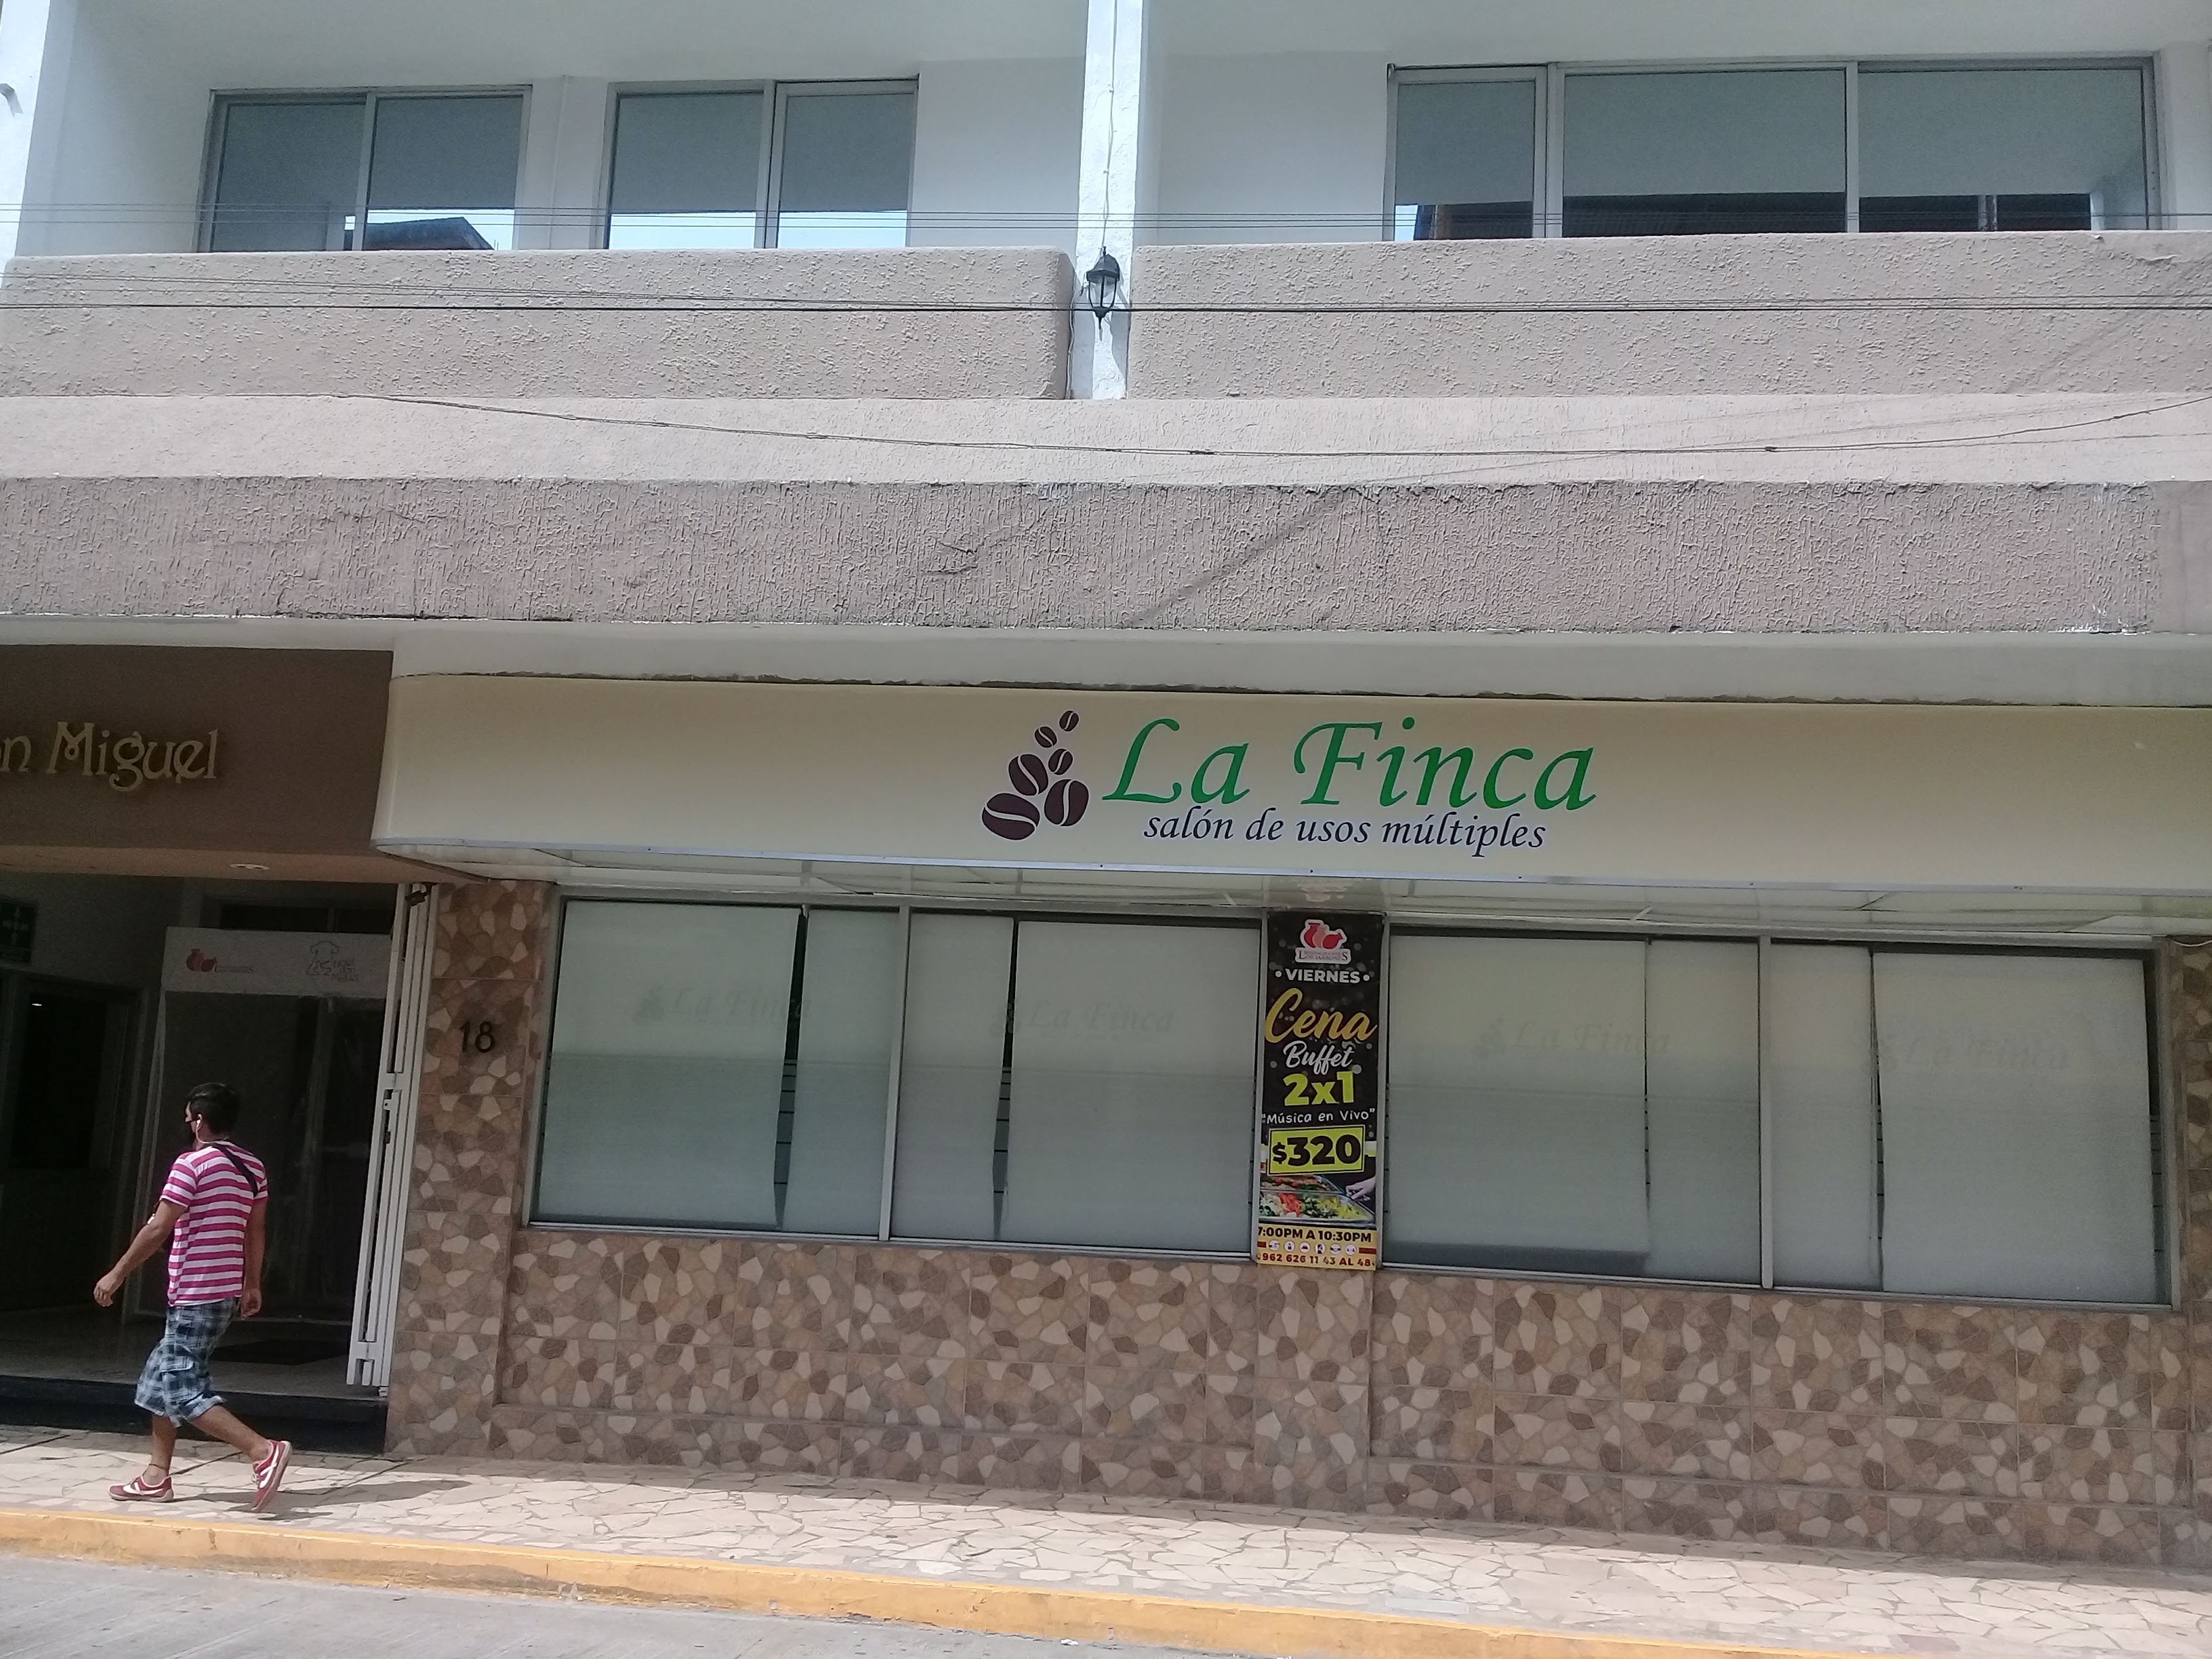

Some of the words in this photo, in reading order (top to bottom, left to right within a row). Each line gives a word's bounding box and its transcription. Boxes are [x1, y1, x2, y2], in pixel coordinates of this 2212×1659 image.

[45, 720, 218, 792] Miguel
[1102, 717, 1250, 806] La
[1293, 716, 1597, 811] Finca
[1143, 806, 1233, 840] salón
[1246, 807, 1284, 841] de
[1297, 818, 1371, 844] usos
[1381, 811, 1547, 857] múltiples
[1285, 968, 1361, 983] VIERNES
[1025, 1000, 1072, 1028] La
[1083, 1001, 1176, 1032] Finca
[1265, 987, 1378, 1043] Cena
[459, 1020, 495, 1052] 18
[1512, 1020, 1561, 1050] La
[1283, 1040, 1355, 1076] Buffet
[1283, 1071, 1355, 1106] 2x1
[1318, 1113, 1334, 1122] en
[1272, 1134, 1361, 1166] $320
[1258, 1227, 1303, 1239] 7:00PM
[1306, 1230, 1316, 1240] A
[1318, 1230, 1372, 1242] 10:30PM
[1262, 1252, 1282, 1262] 962
[1286, 1254, 1307, 1263] 626
[1309, 1256, 1319, 1264] 11
[1323, 1256, 1336, 1265] 43
[1338, 1257, 1354, 1266] AL
[1357, 1258, 1371, 1267] 48
